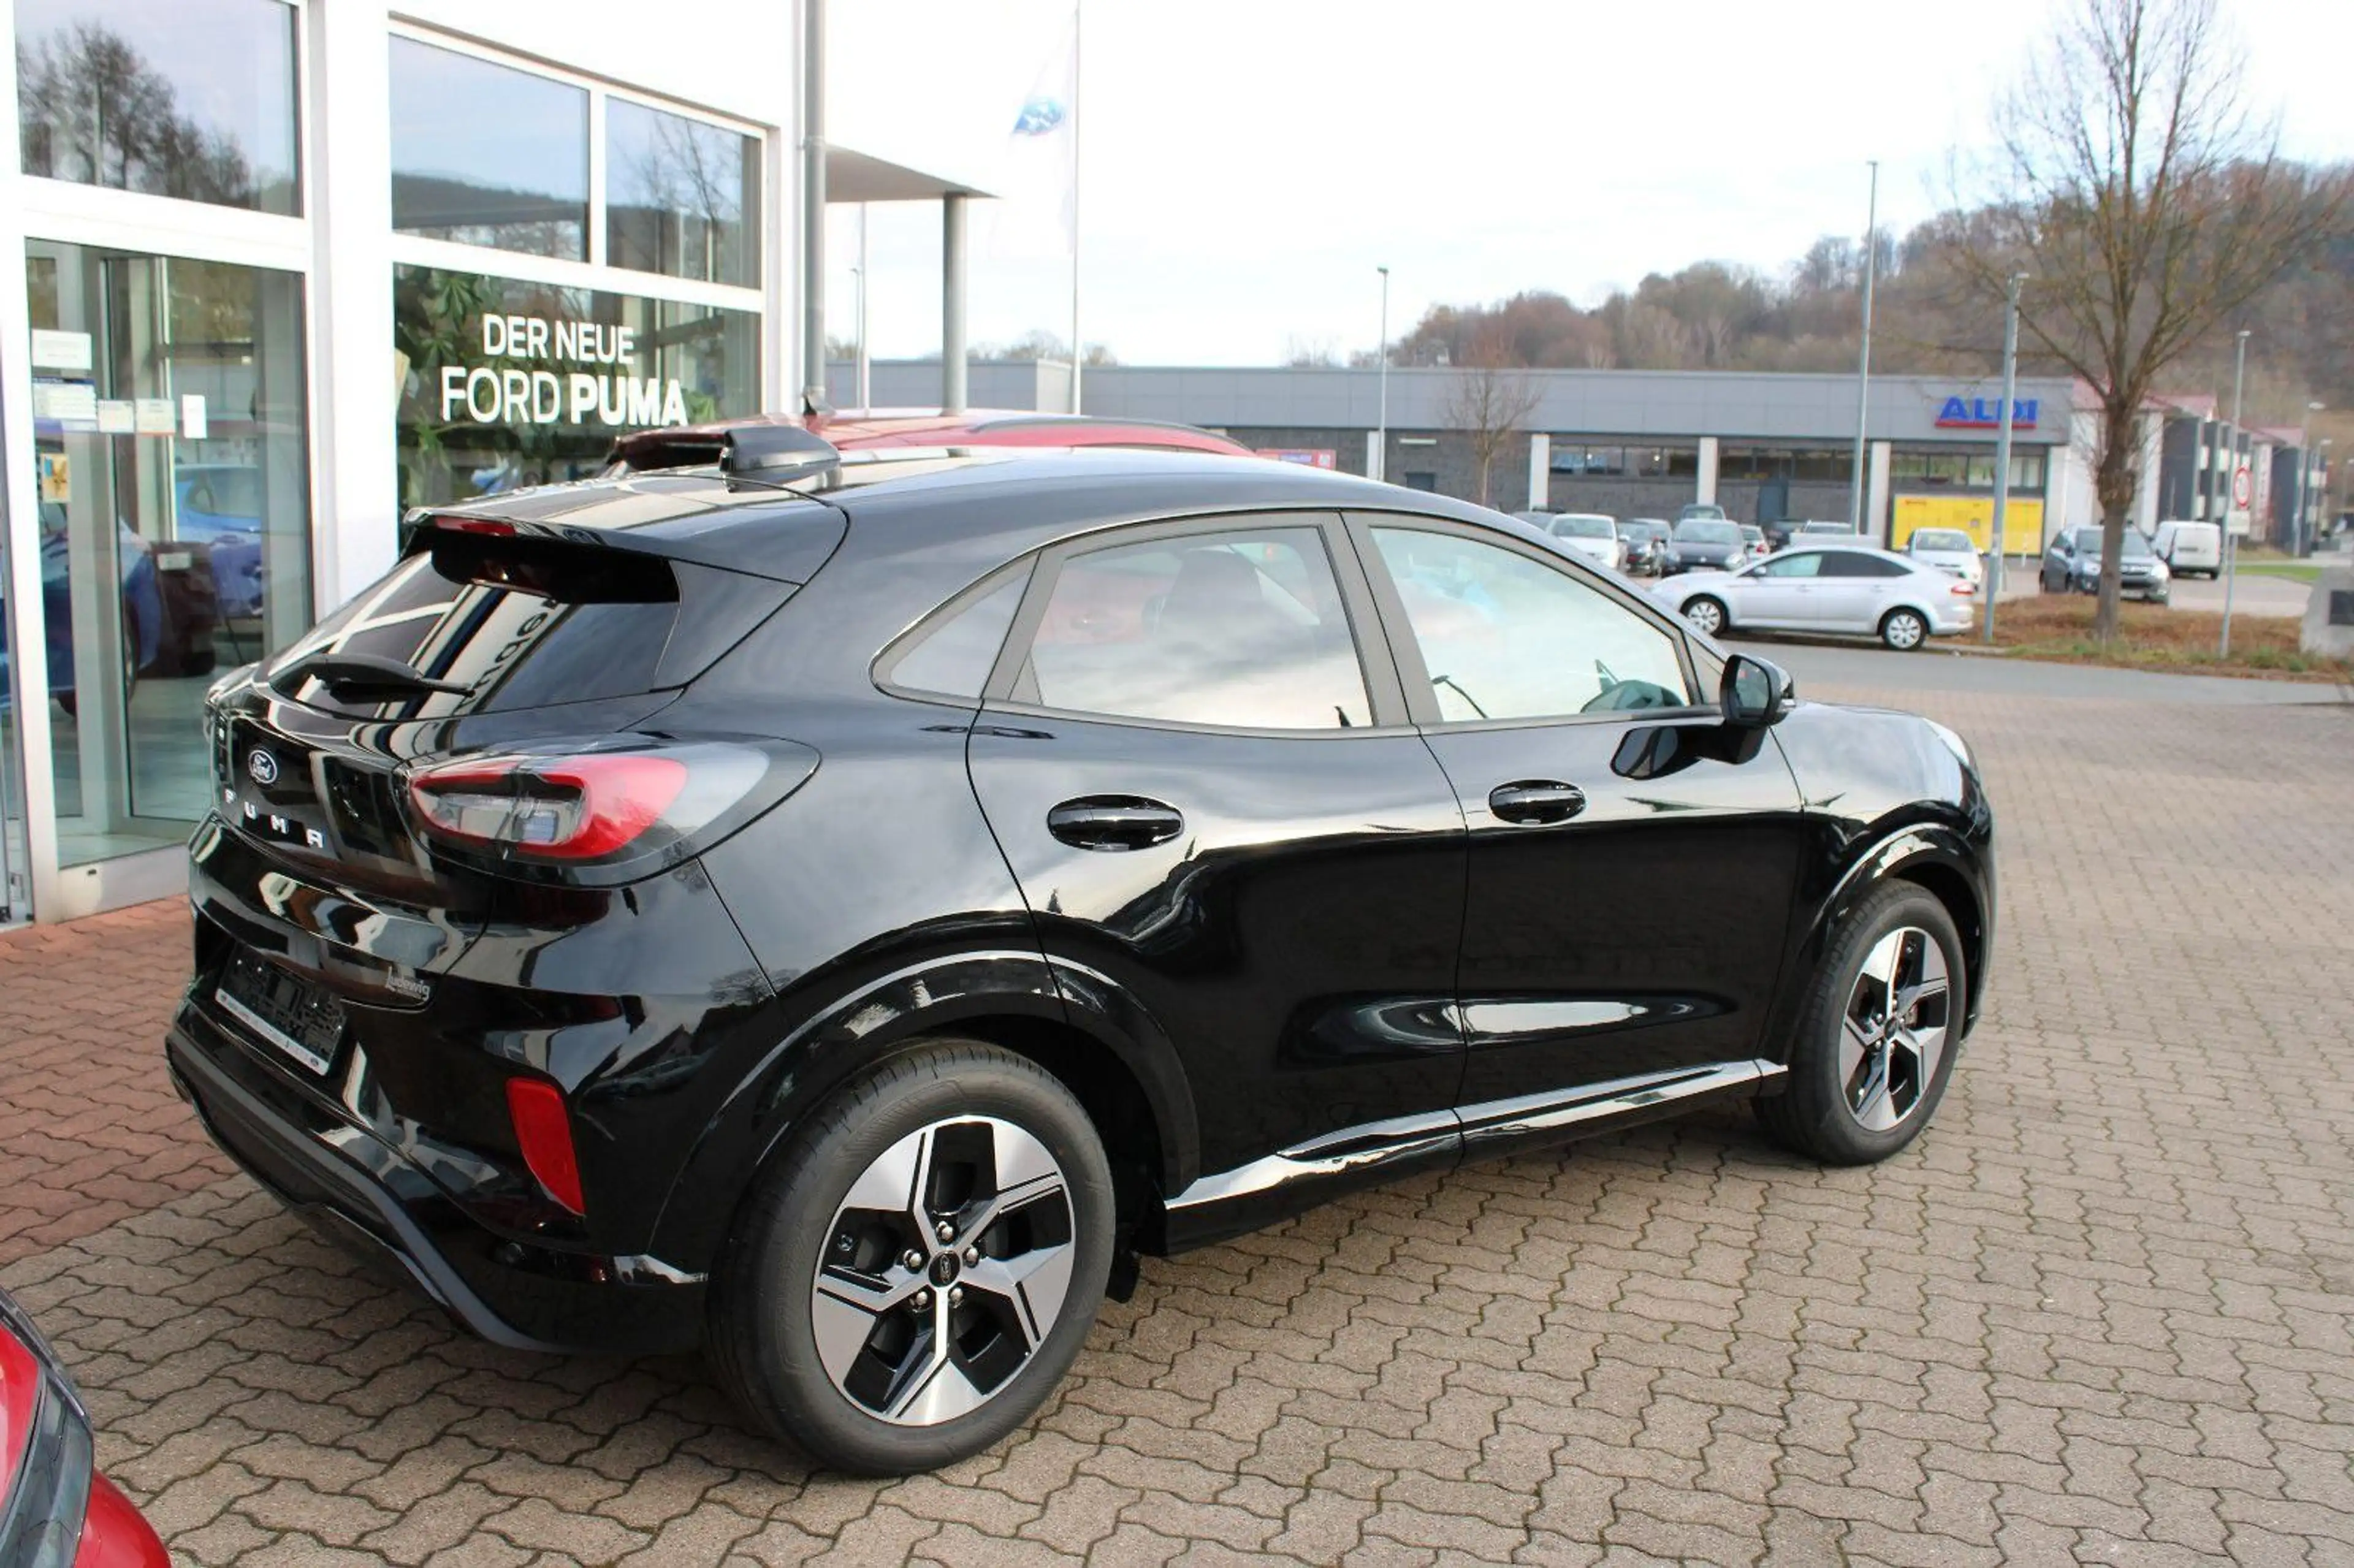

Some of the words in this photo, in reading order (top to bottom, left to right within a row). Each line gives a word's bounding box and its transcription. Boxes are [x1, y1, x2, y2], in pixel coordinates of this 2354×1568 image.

[482, 313, 548, 359] DER
[555, 320, 634, 365] NEUE
[441, 366, 560, 424] FORD
[569, 373, 688, 427] PUMA
[1940, 397, 2038, 421] ALDI
[224, 788, 324, 848] PUMA
[384, 965, 431, 1002] Ludewig
